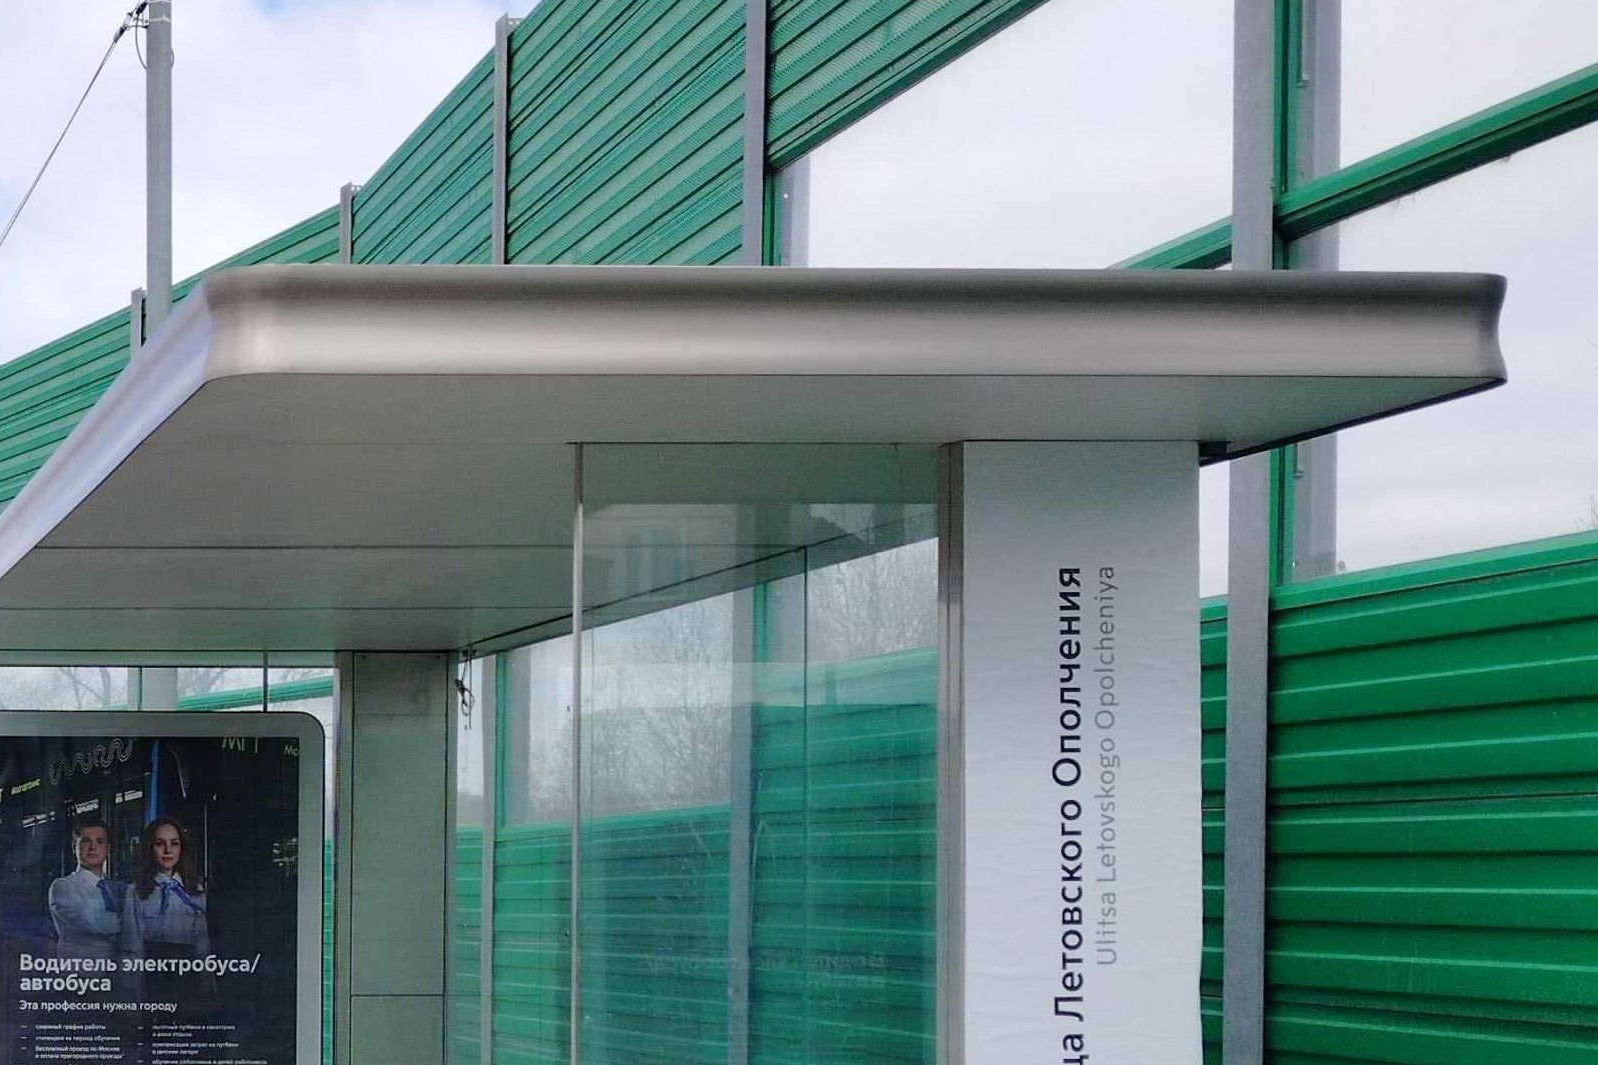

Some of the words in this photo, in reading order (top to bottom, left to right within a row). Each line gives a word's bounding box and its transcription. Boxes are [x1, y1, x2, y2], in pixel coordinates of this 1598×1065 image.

[1052, 567, 1082, 787] Ополчения
[1093, 566, 1119, 729] Opolcheniya
[1093, 738, 1120, 882] Letovskogo
[19, 953, 118, 974] Водитель
[122, 953, 261, 976] электробуса/
[1054, 799, 1084, 1022] Летовского
[1095, 892, 1117, 965] Ulitsa
[19, 974, 112, 995] автобуса
[19, 1001, 39, 1011] Эта
[41, 1001, 100, 1012] профессия
[102, 1002, 137, 1012] нужна
[139, 1002, 177, 1012] городу
